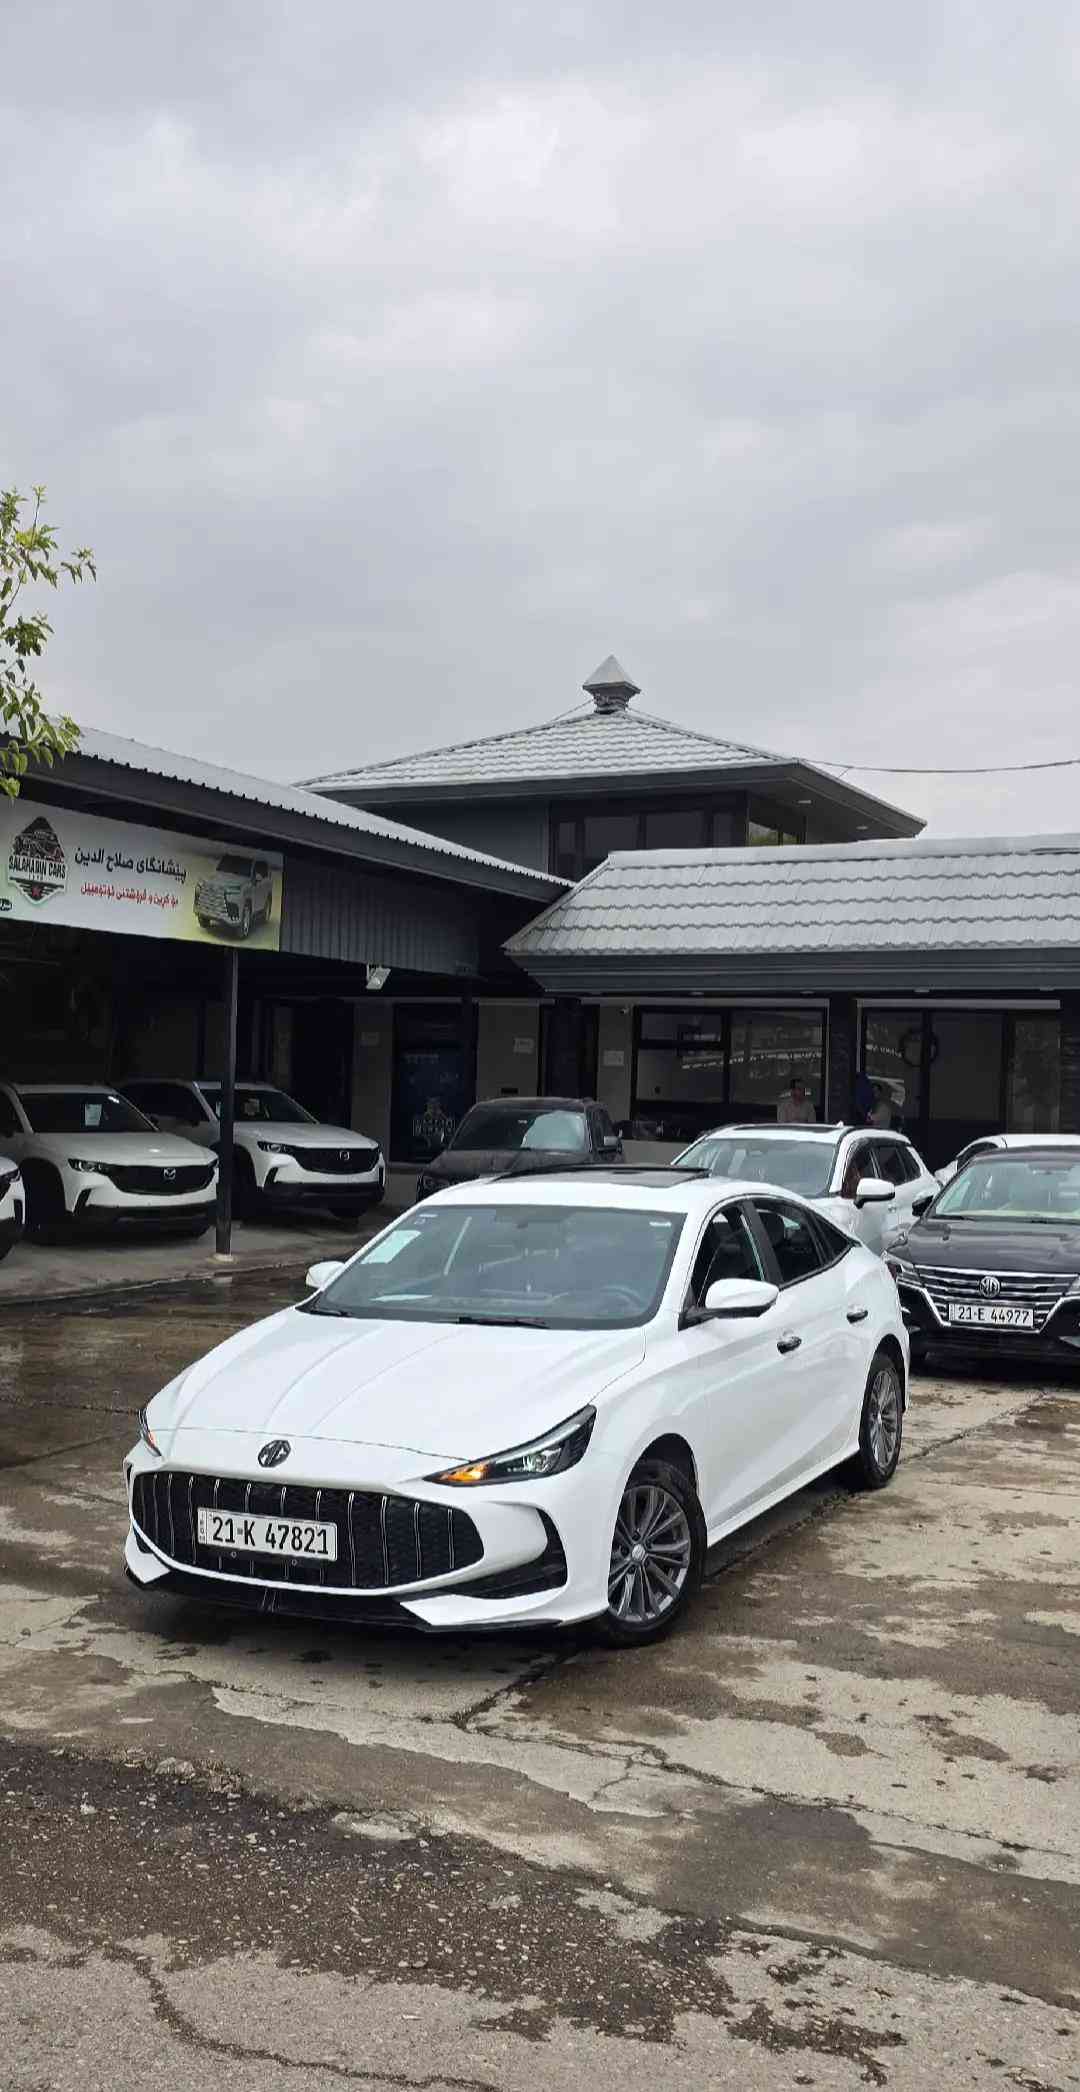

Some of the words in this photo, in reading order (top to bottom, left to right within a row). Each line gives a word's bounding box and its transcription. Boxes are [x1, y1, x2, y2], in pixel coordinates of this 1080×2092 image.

[48, 862, 66, 879] CARS
[212, 1516, 256, 1547] 21-K
[264, 1522, 329, 1555] 47821
